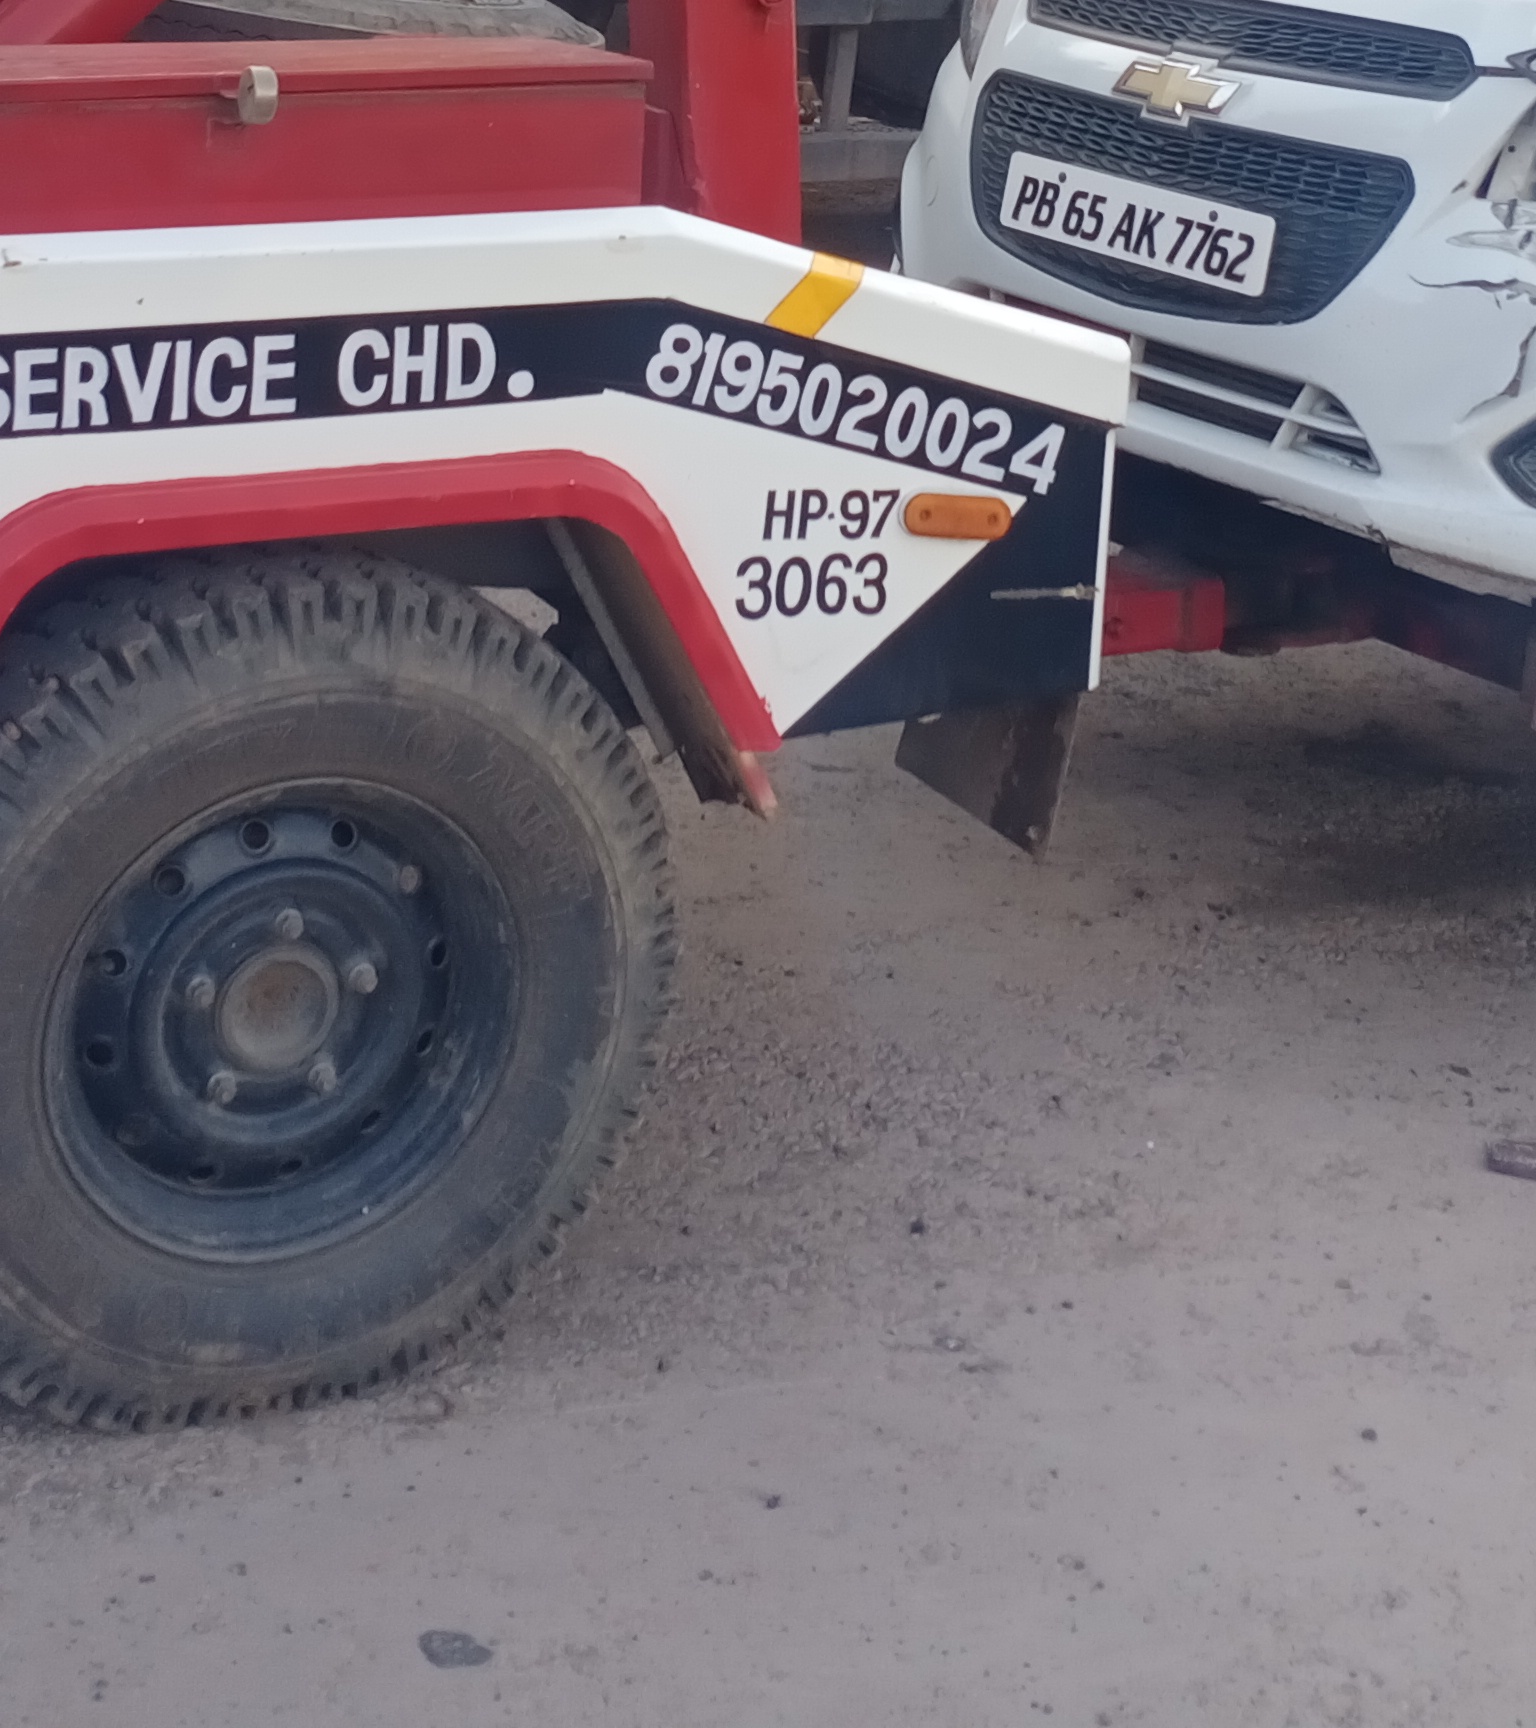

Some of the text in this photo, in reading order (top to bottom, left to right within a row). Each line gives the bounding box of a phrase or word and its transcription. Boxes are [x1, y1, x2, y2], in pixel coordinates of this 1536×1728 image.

[1011, 175, 1255, 284] PB 65 AK 7762
[336, 322, 536, 409] CHD.
[645, 323, 1067, 496] 8195020024
[735, 552, 889, 620] 3063
